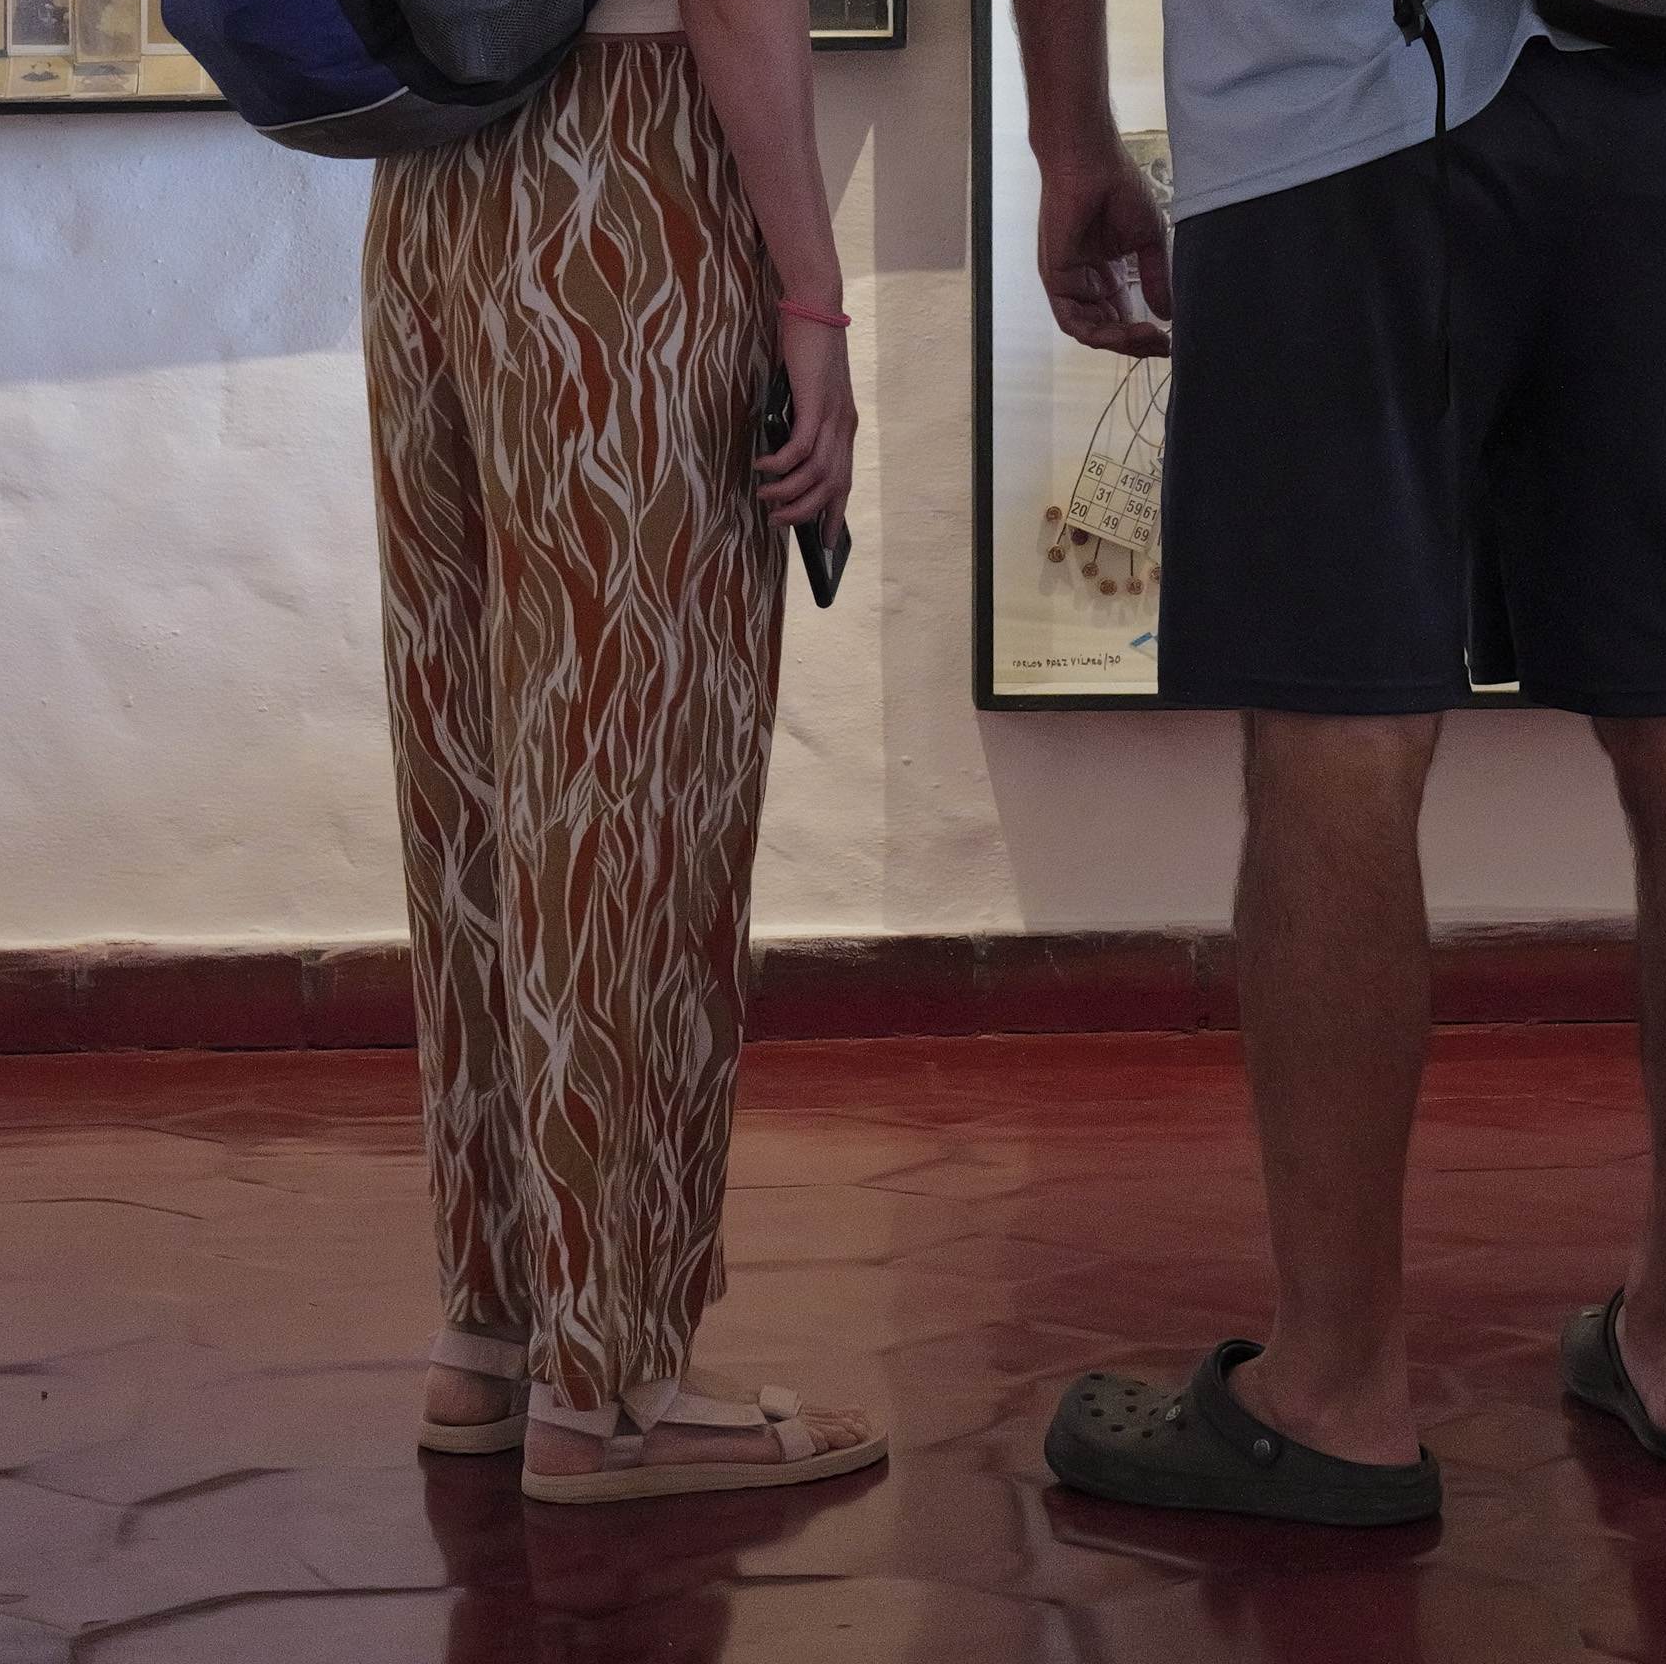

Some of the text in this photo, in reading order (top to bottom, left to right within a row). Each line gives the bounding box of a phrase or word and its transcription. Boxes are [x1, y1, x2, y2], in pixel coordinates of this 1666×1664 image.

[1088, 460, 1104, 477] 26
[1120, 474, 1151, 495] 41 50
[1096, 487, 1112, 504] 31
[1071, 501, 1088, 518] 20
[1126, 499, 1158, 521] 59 61
[1102, 515, 1119, 530] 49
[1134, 527, 1150, 542] 69
[1012, 660, 1042, 668] CARLOS
